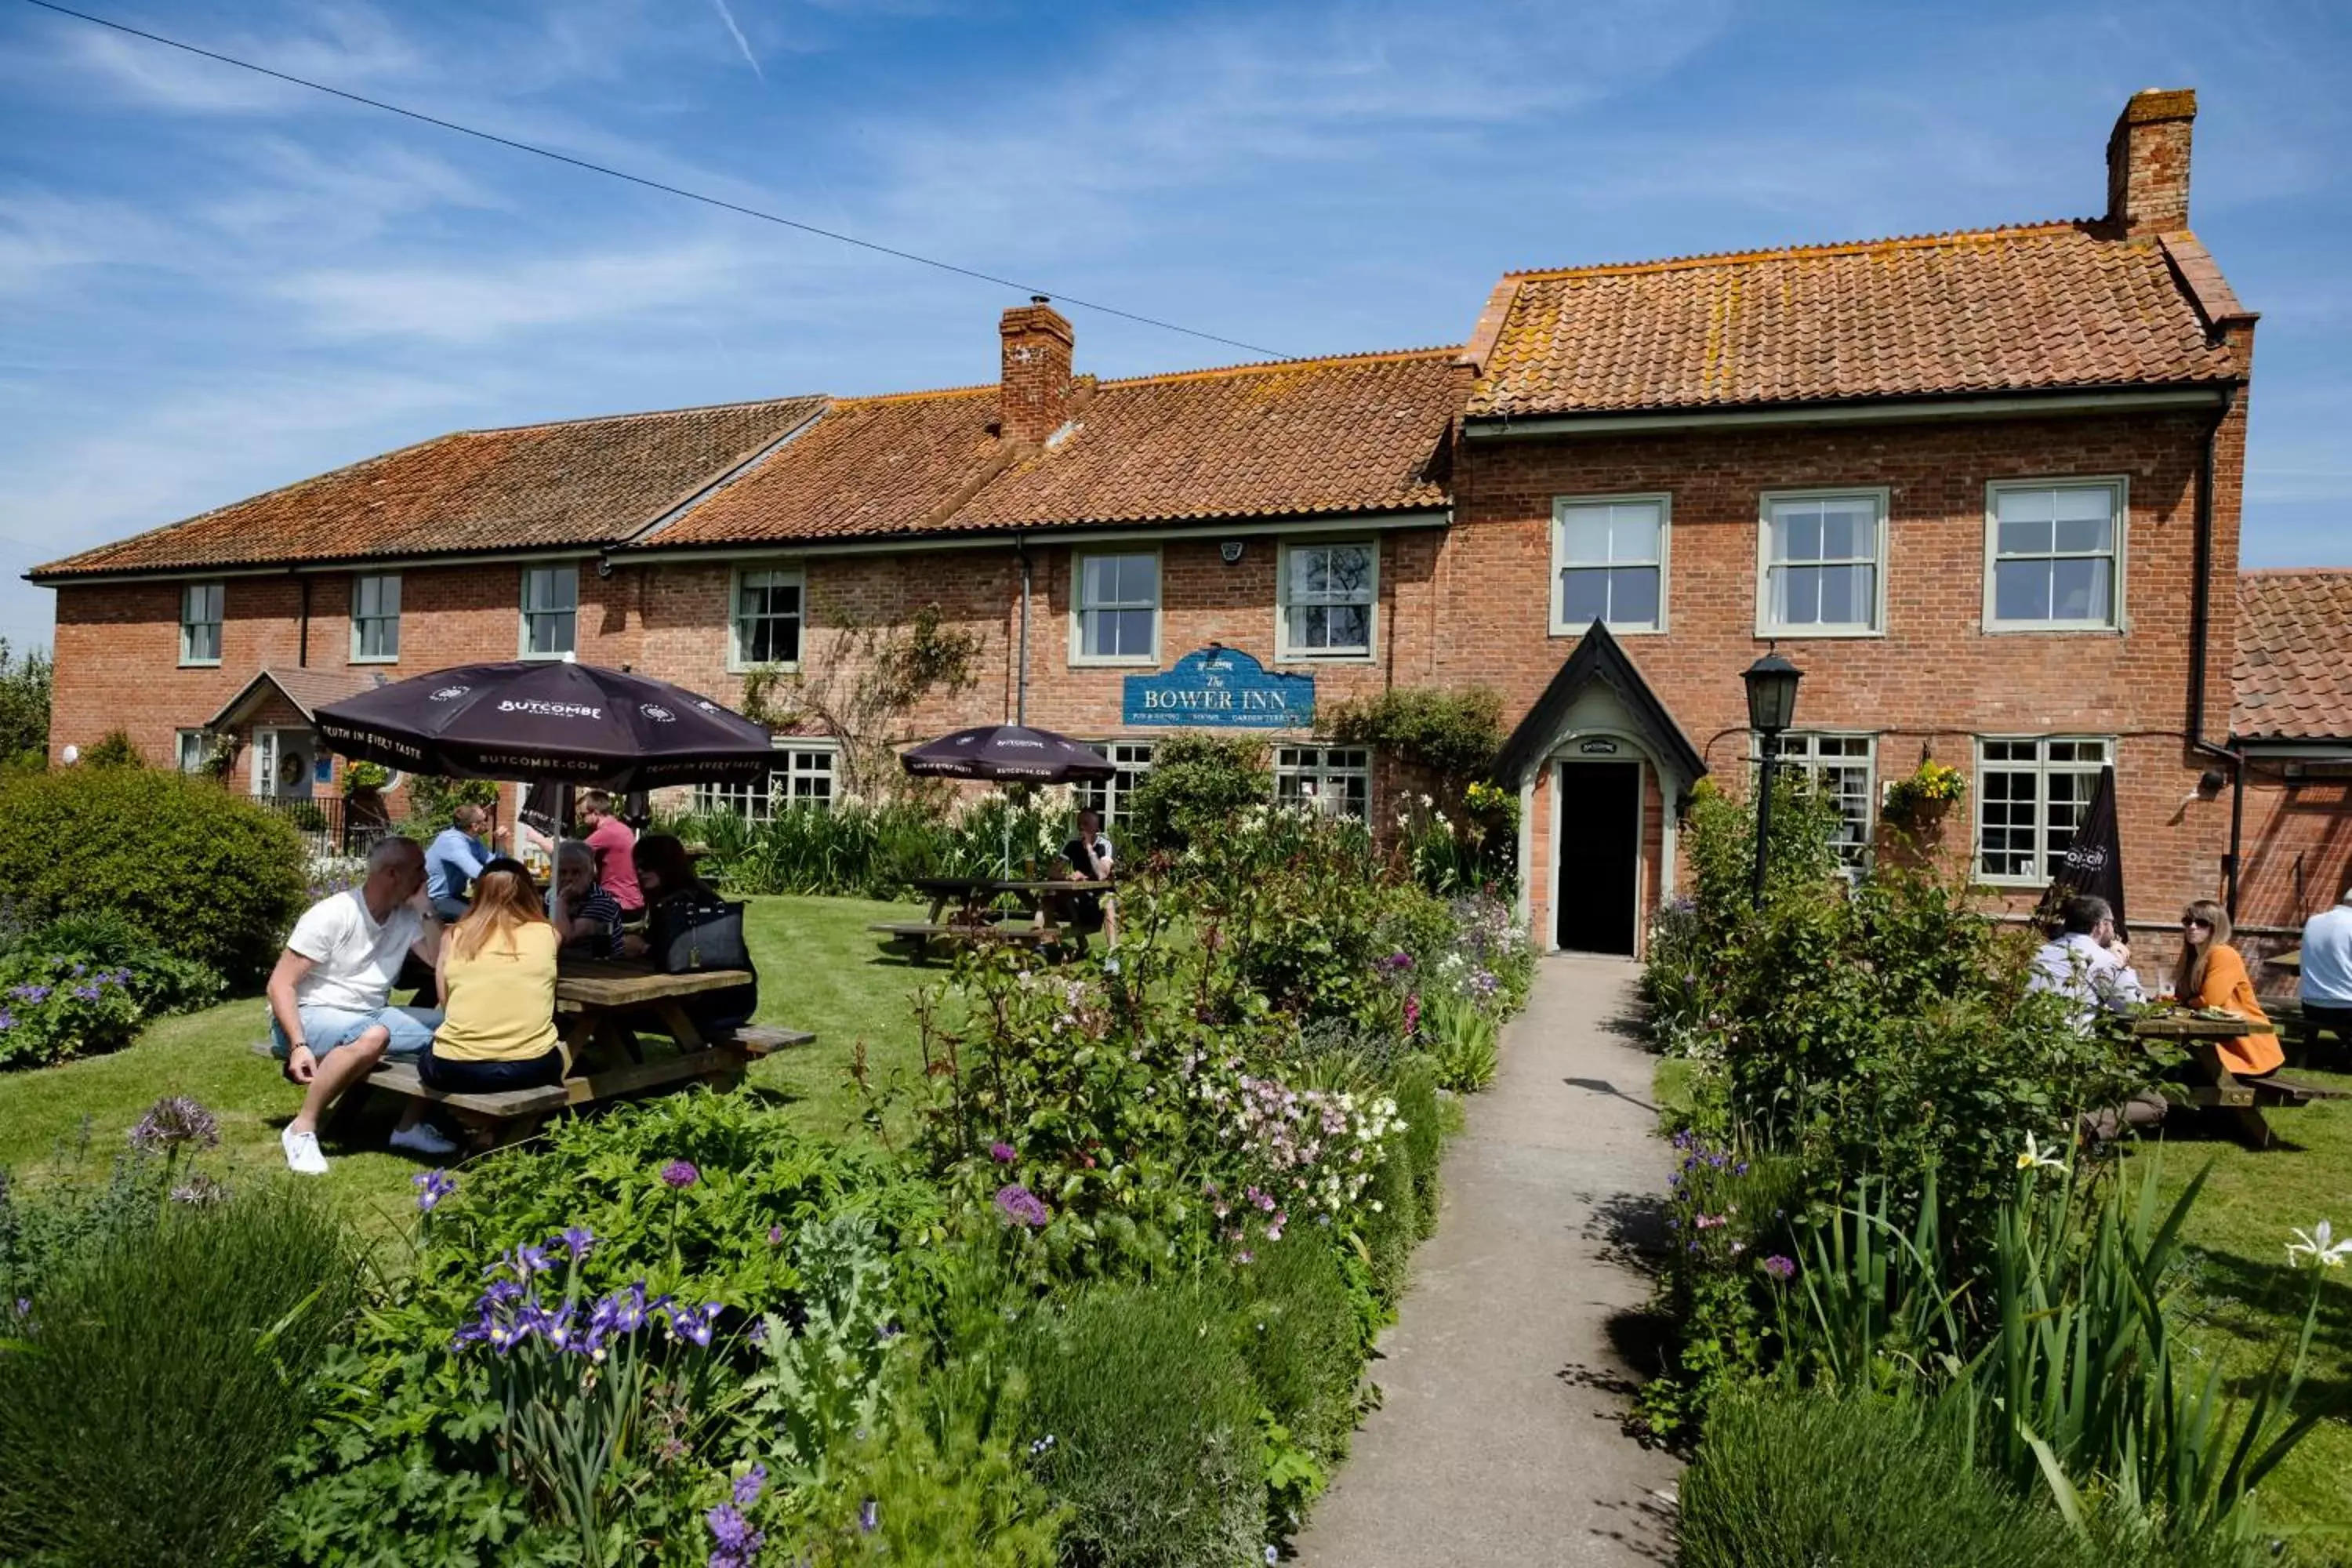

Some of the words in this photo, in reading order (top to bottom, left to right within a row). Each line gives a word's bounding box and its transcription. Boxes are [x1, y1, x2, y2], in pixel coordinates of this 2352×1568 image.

[497, 699, 601, 720] BUTCOMBE
[1145, 690, 1232, 710] BOWER
[1241, 691, 1287, 710] INN
[322, 725, 350, 739] TRUTH
[354, 730, 365, 741] IN
[368, 733, 392, 750] EVERY
[395, 741, 422, 760] TASTE
[479, 755, 600, 771] BUTCOMBE.COM
